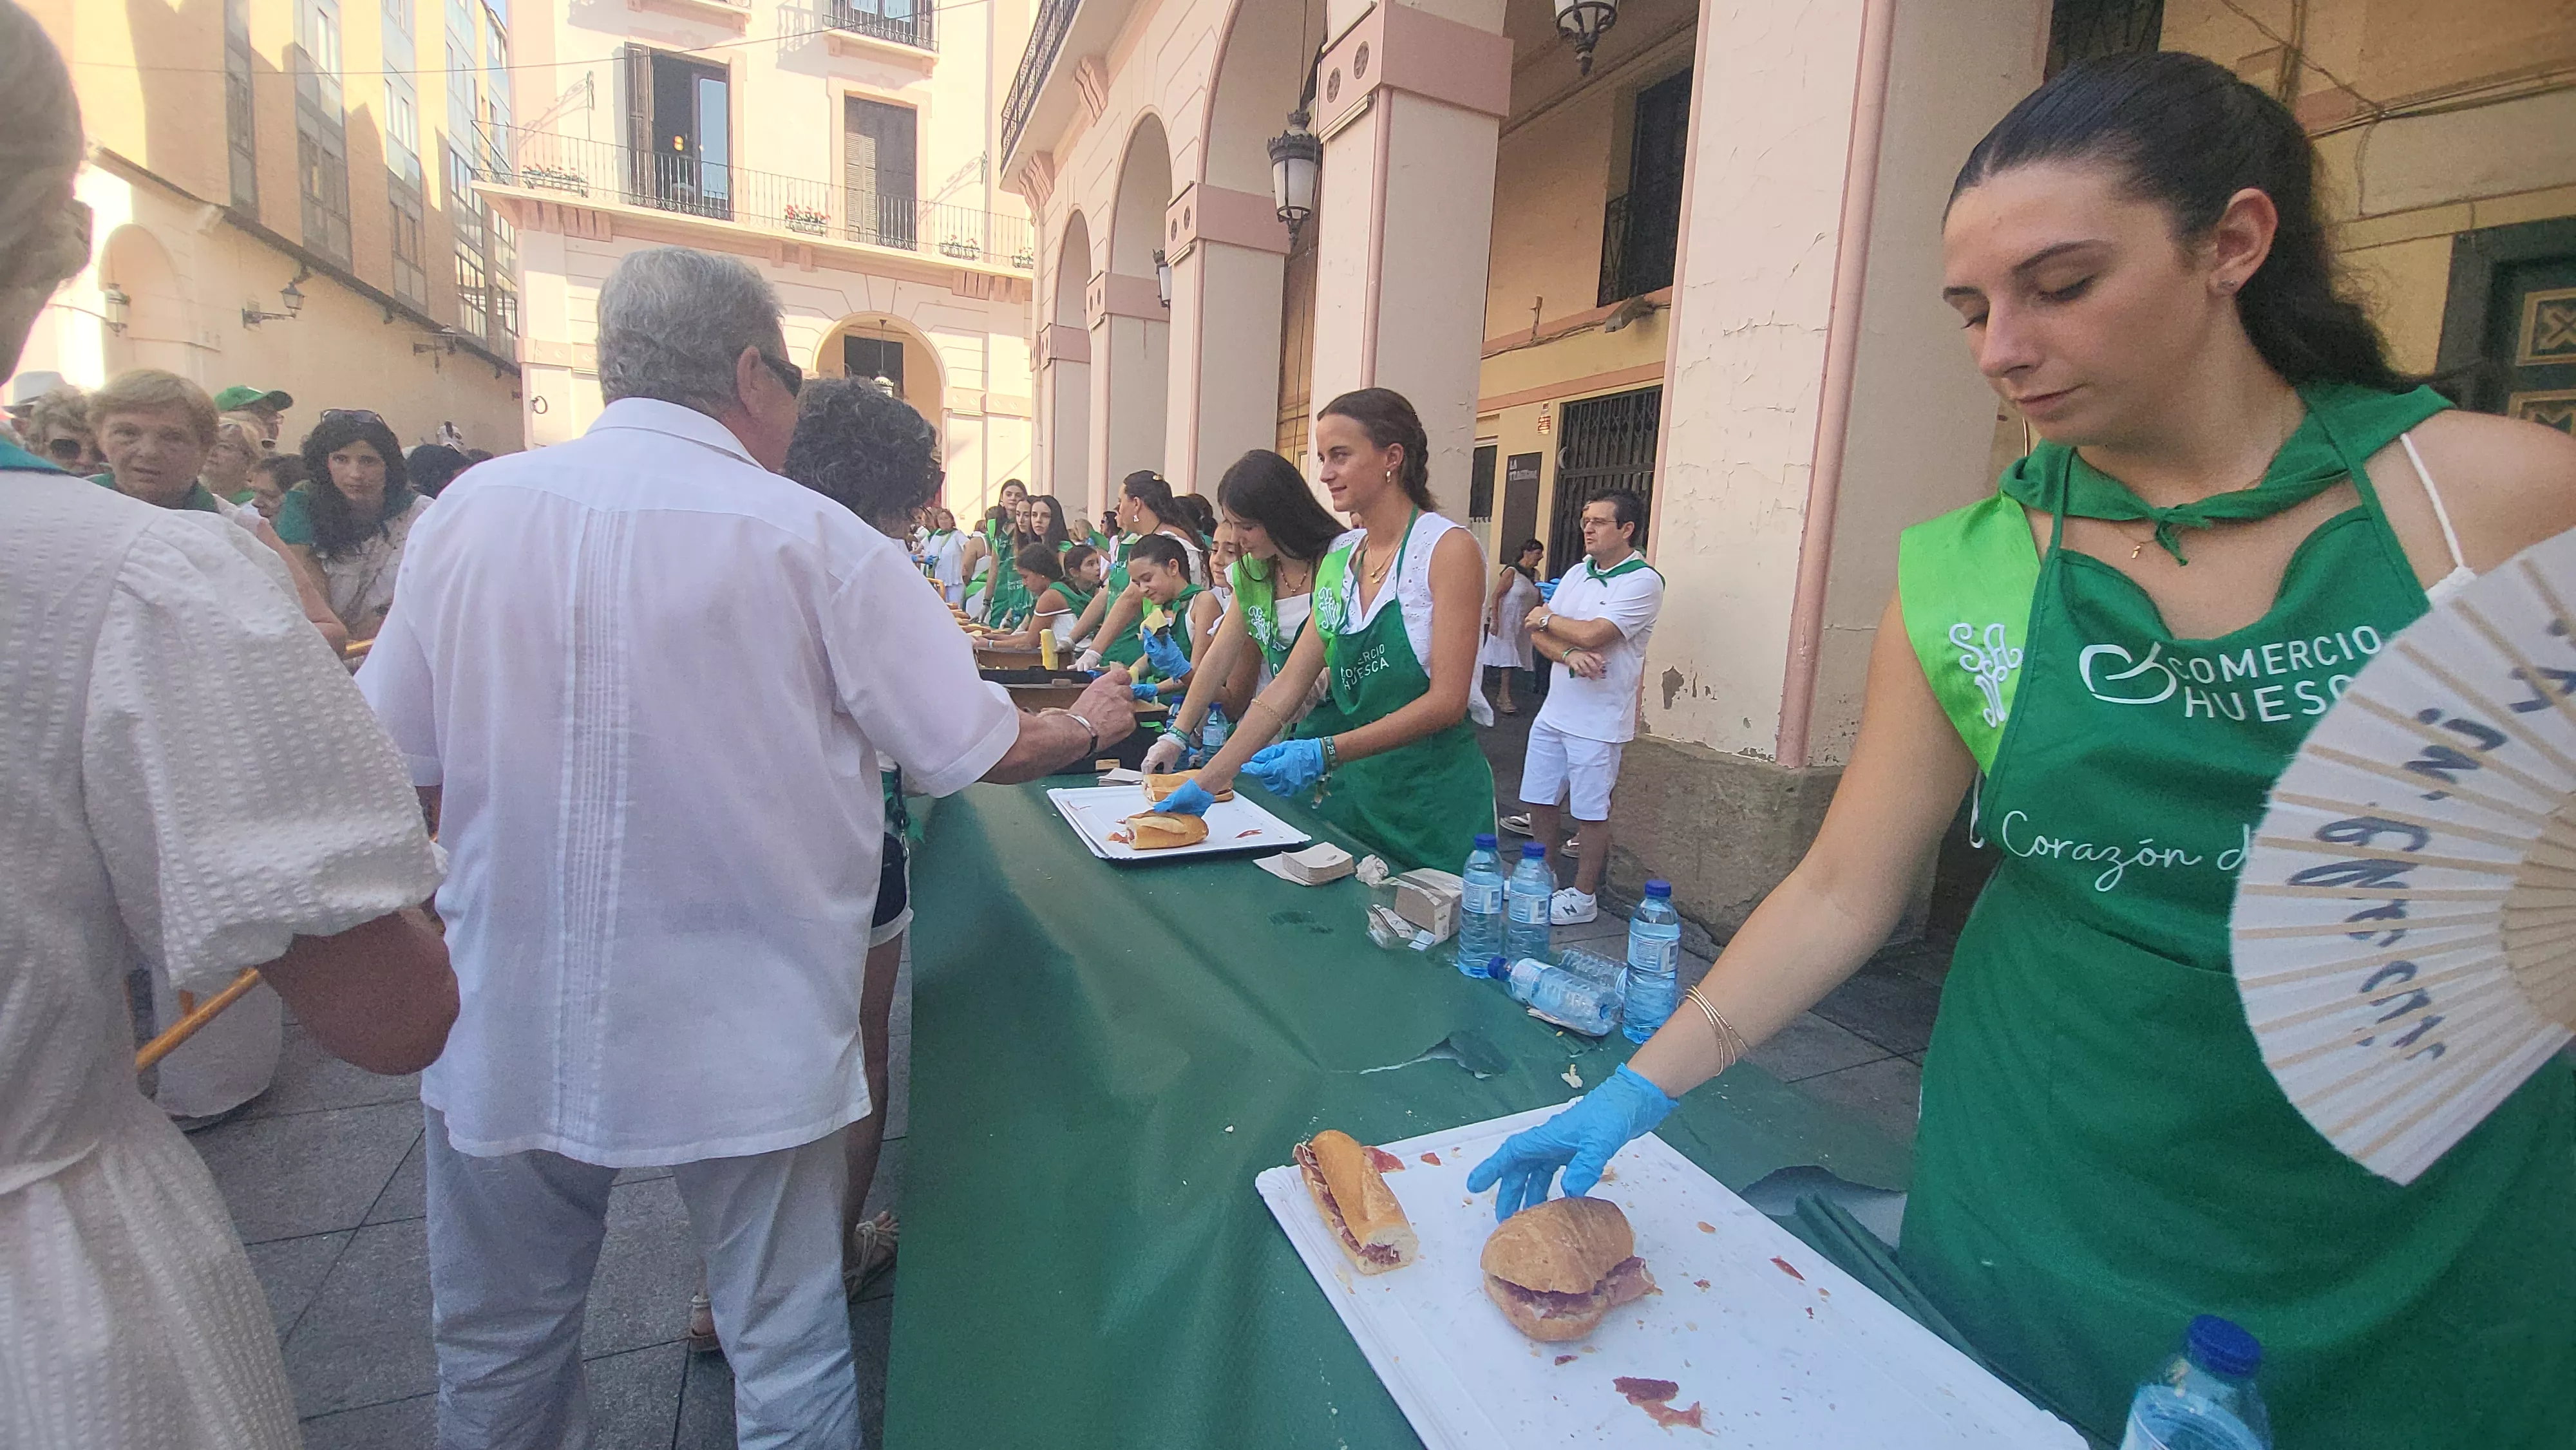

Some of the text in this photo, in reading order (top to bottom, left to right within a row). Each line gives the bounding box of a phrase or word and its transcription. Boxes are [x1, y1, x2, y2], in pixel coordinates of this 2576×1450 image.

[1340, 644, 1385, 678] COERCIO
[1344, 657, 1390, 690] HUESCA
[2168, 626, 2382, 684] COMERCIO
[2184, 674, 2353, 722] HUESC
[2002, 810, 2202, 892] Corazón
